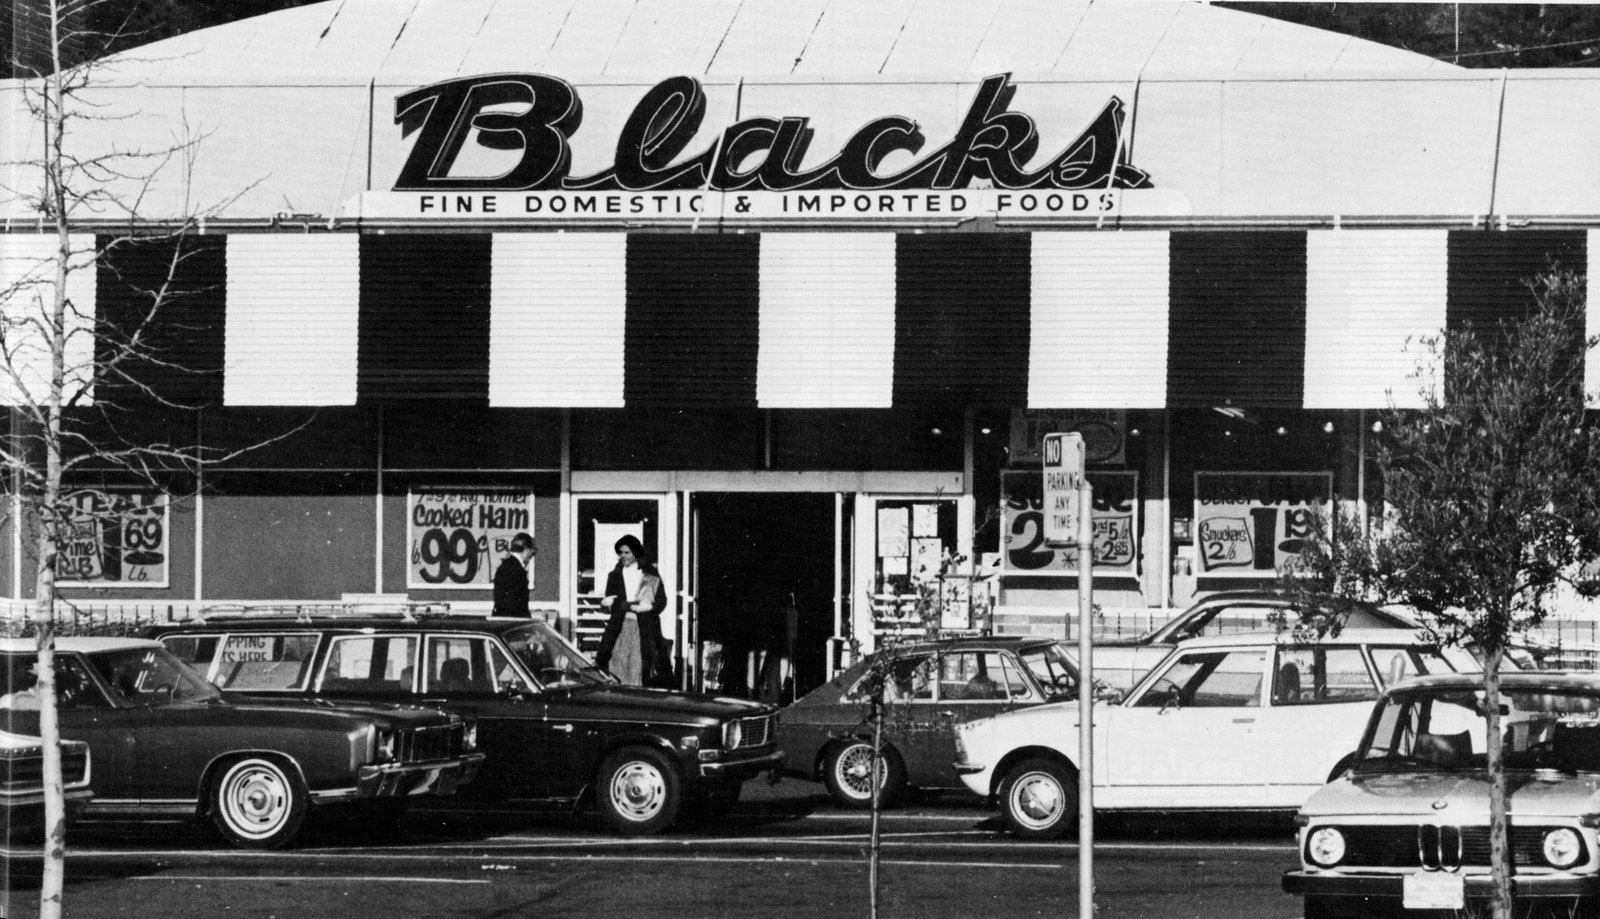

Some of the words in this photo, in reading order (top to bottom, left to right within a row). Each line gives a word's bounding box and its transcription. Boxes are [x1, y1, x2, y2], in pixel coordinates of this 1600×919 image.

[394, 71, 1154, 191] Blacks
[420, 195, 497, 213] FINE
[526, 195, 704, 213] DOMESTIC
[734, 195, 752, 213] &
[783, 194, 967, 212] IMPORTED
[998, 193, 1114, 212] FOODS
[1046, 439, 1060, 463] NO
[1047, 472, 1080, 491] PARKING
[1055, 496, 1070, 510] ANY
[413, 503, 473, 529] Cooked
[480, 504, 529, 530] Ham
[1053, 514, 1072, 529] TIME
